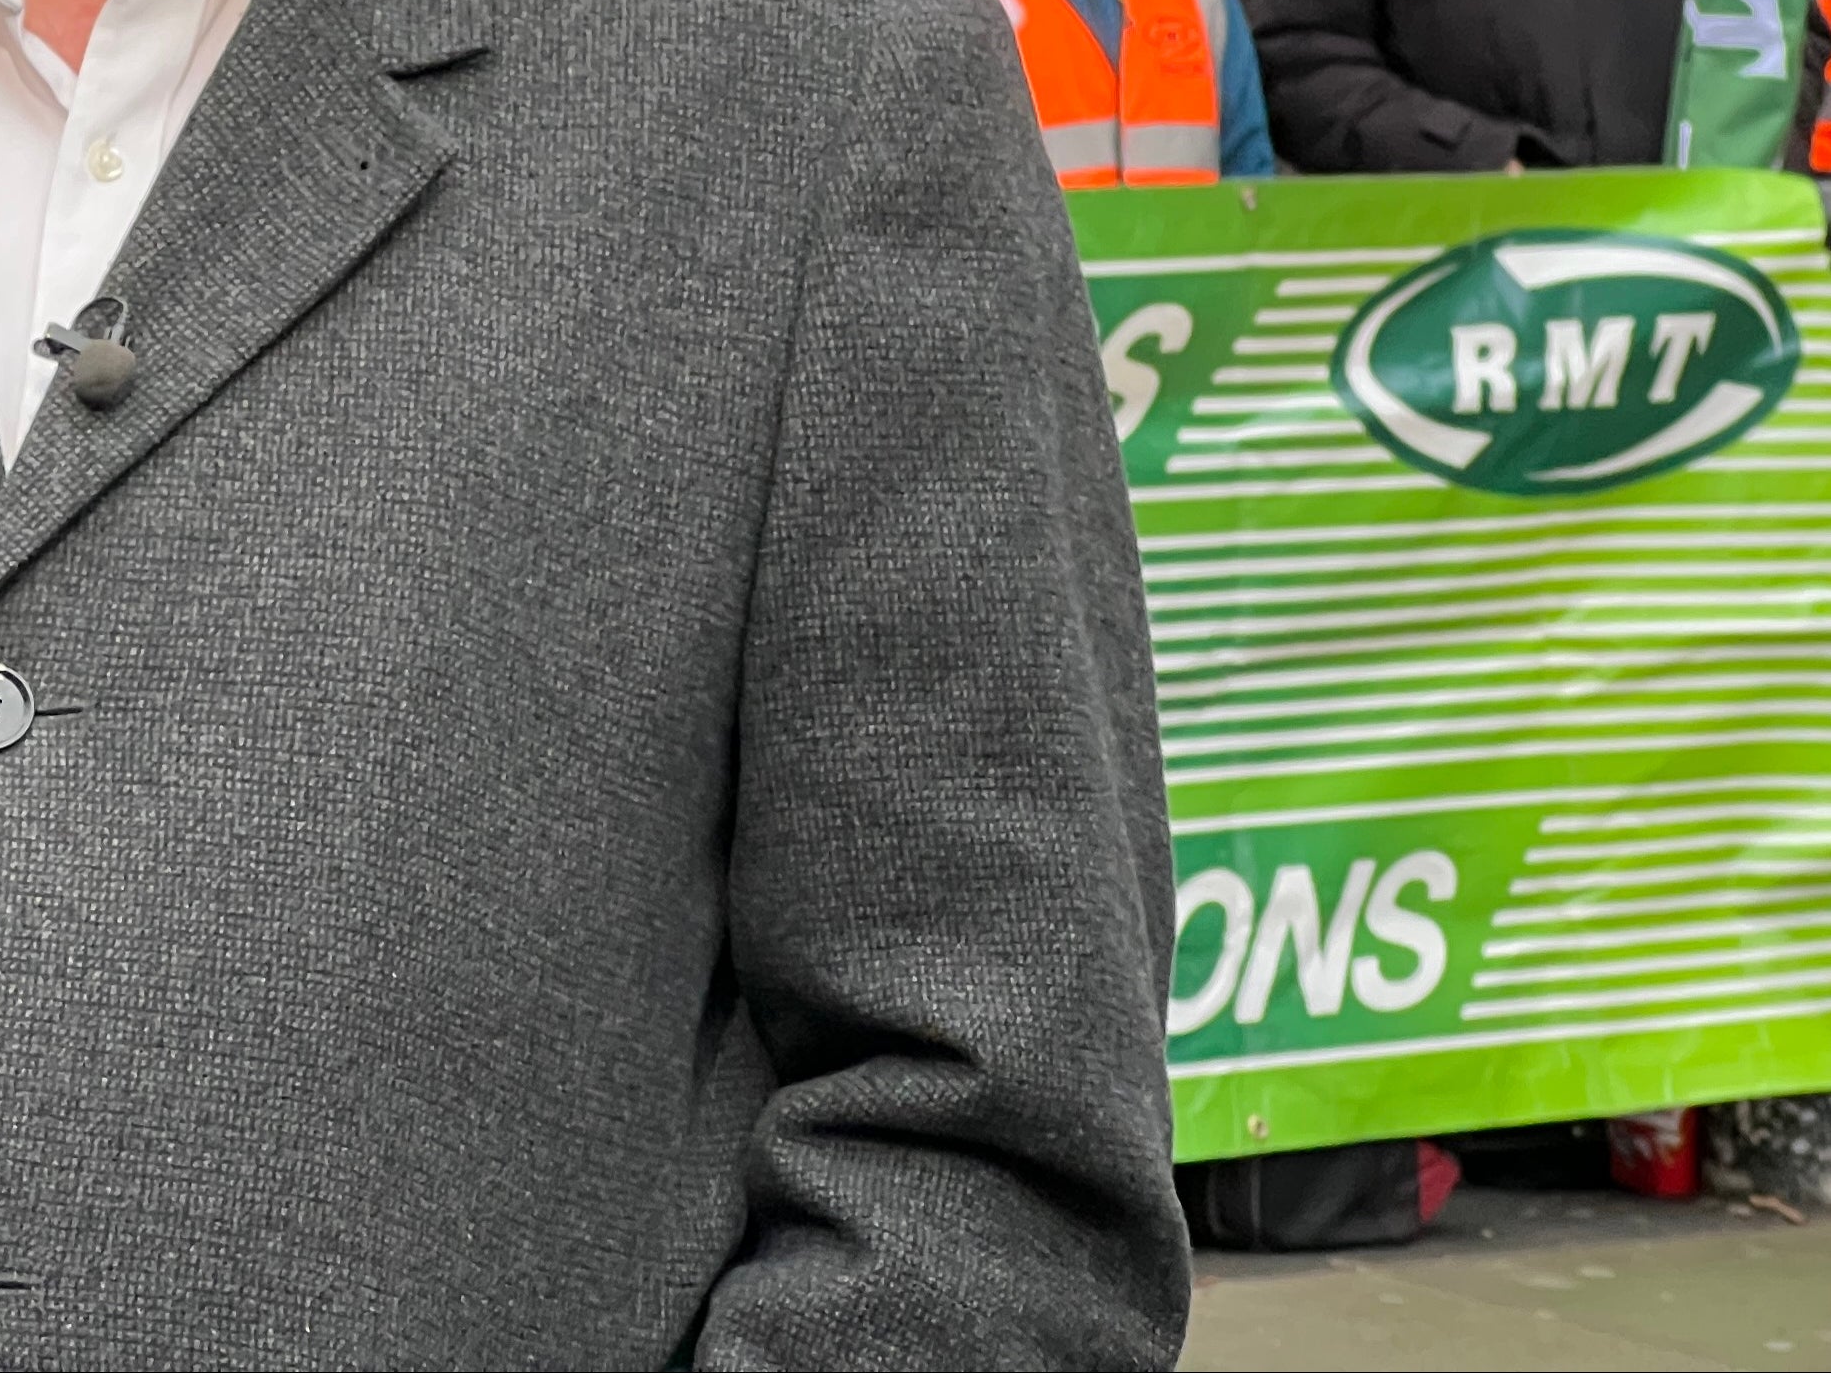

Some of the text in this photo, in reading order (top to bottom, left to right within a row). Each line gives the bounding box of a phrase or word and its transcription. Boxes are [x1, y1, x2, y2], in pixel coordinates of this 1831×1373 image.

[1098, 301, 1194, 443] S
[1449, 311, 1717, 415] RMT
[1166, 846, 1459, 1037] ONS
